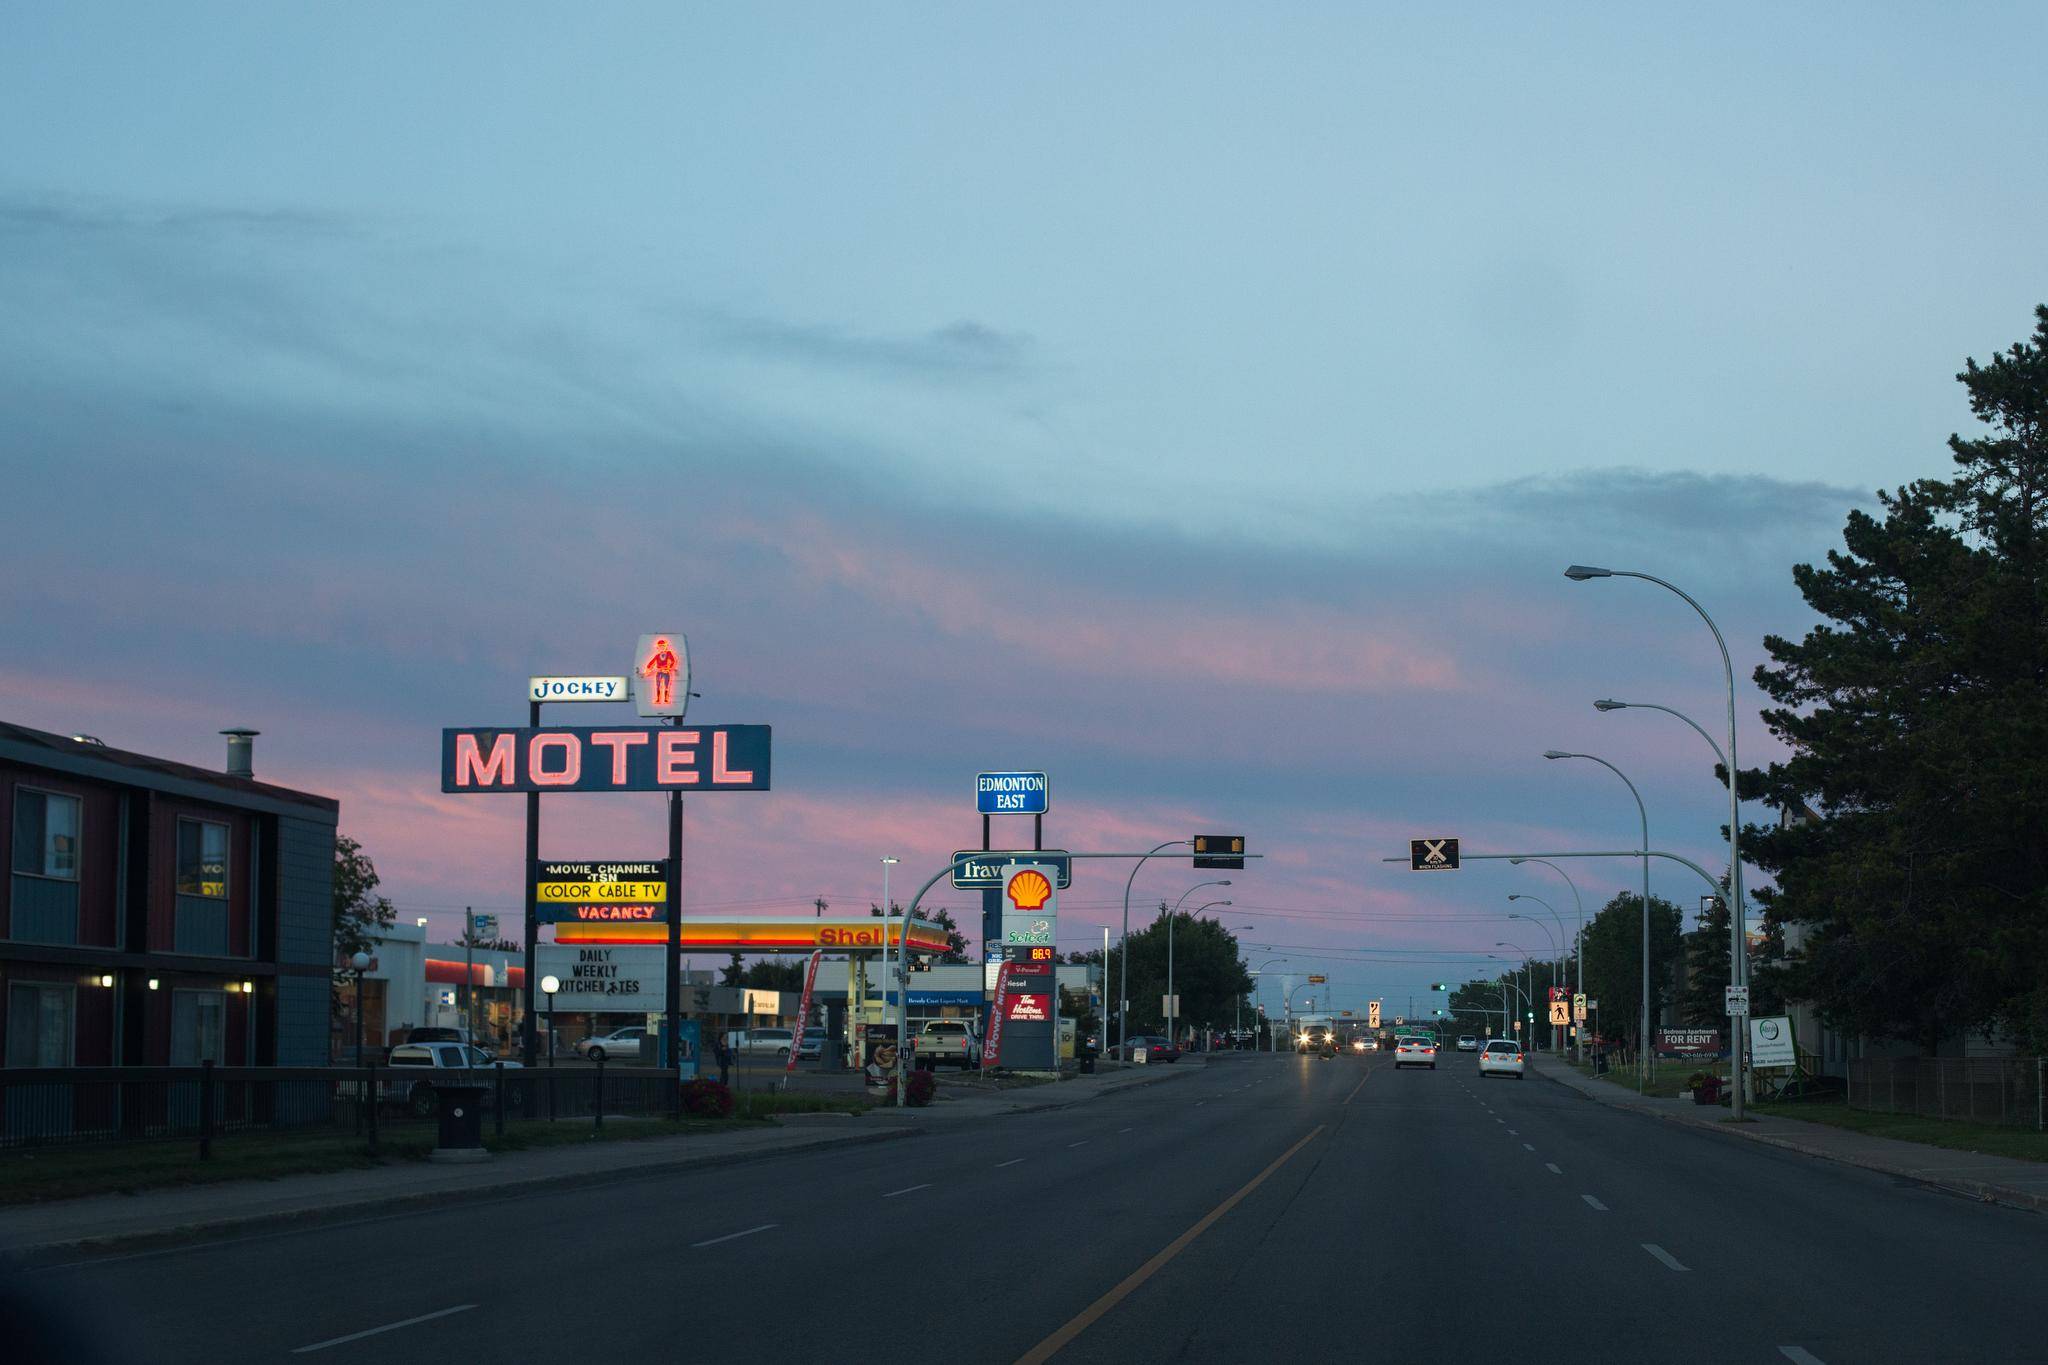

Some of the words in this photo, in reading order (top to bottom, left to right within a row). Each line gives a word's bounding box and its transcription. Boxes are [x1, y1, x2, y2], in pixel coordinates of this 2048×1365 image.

[456, 731, 753, 786] MOTEL
[979, 777, 1044, 791] EDMONTON
[996, 794, 1025, 808] EAST
[550, 864, 591, 874] MOVIE
[598, 864, 659, 874] CHANNEL
[591, 873, 618, 882] TSN
[544, 884, 591, 898] COLOR
[598, 884, 636, 898] CABLE
[643, 885, 661, 897] TV
[578, 905, 655, 919] VACANCY
[820, 928, 886, 945] Shel
[1009, 931, 1049, 943] Select
[580, 950, 612, 962] DAILY
[572, 965, 618, 978] WEEKLY
[1020, 995, 1036, 1005] Tim
[1687, 1028, 1718, 1036] Apartments
[1665, 1035, 1685, 1044] FOR
[1687, 1035, 1712, 1044] RENT
